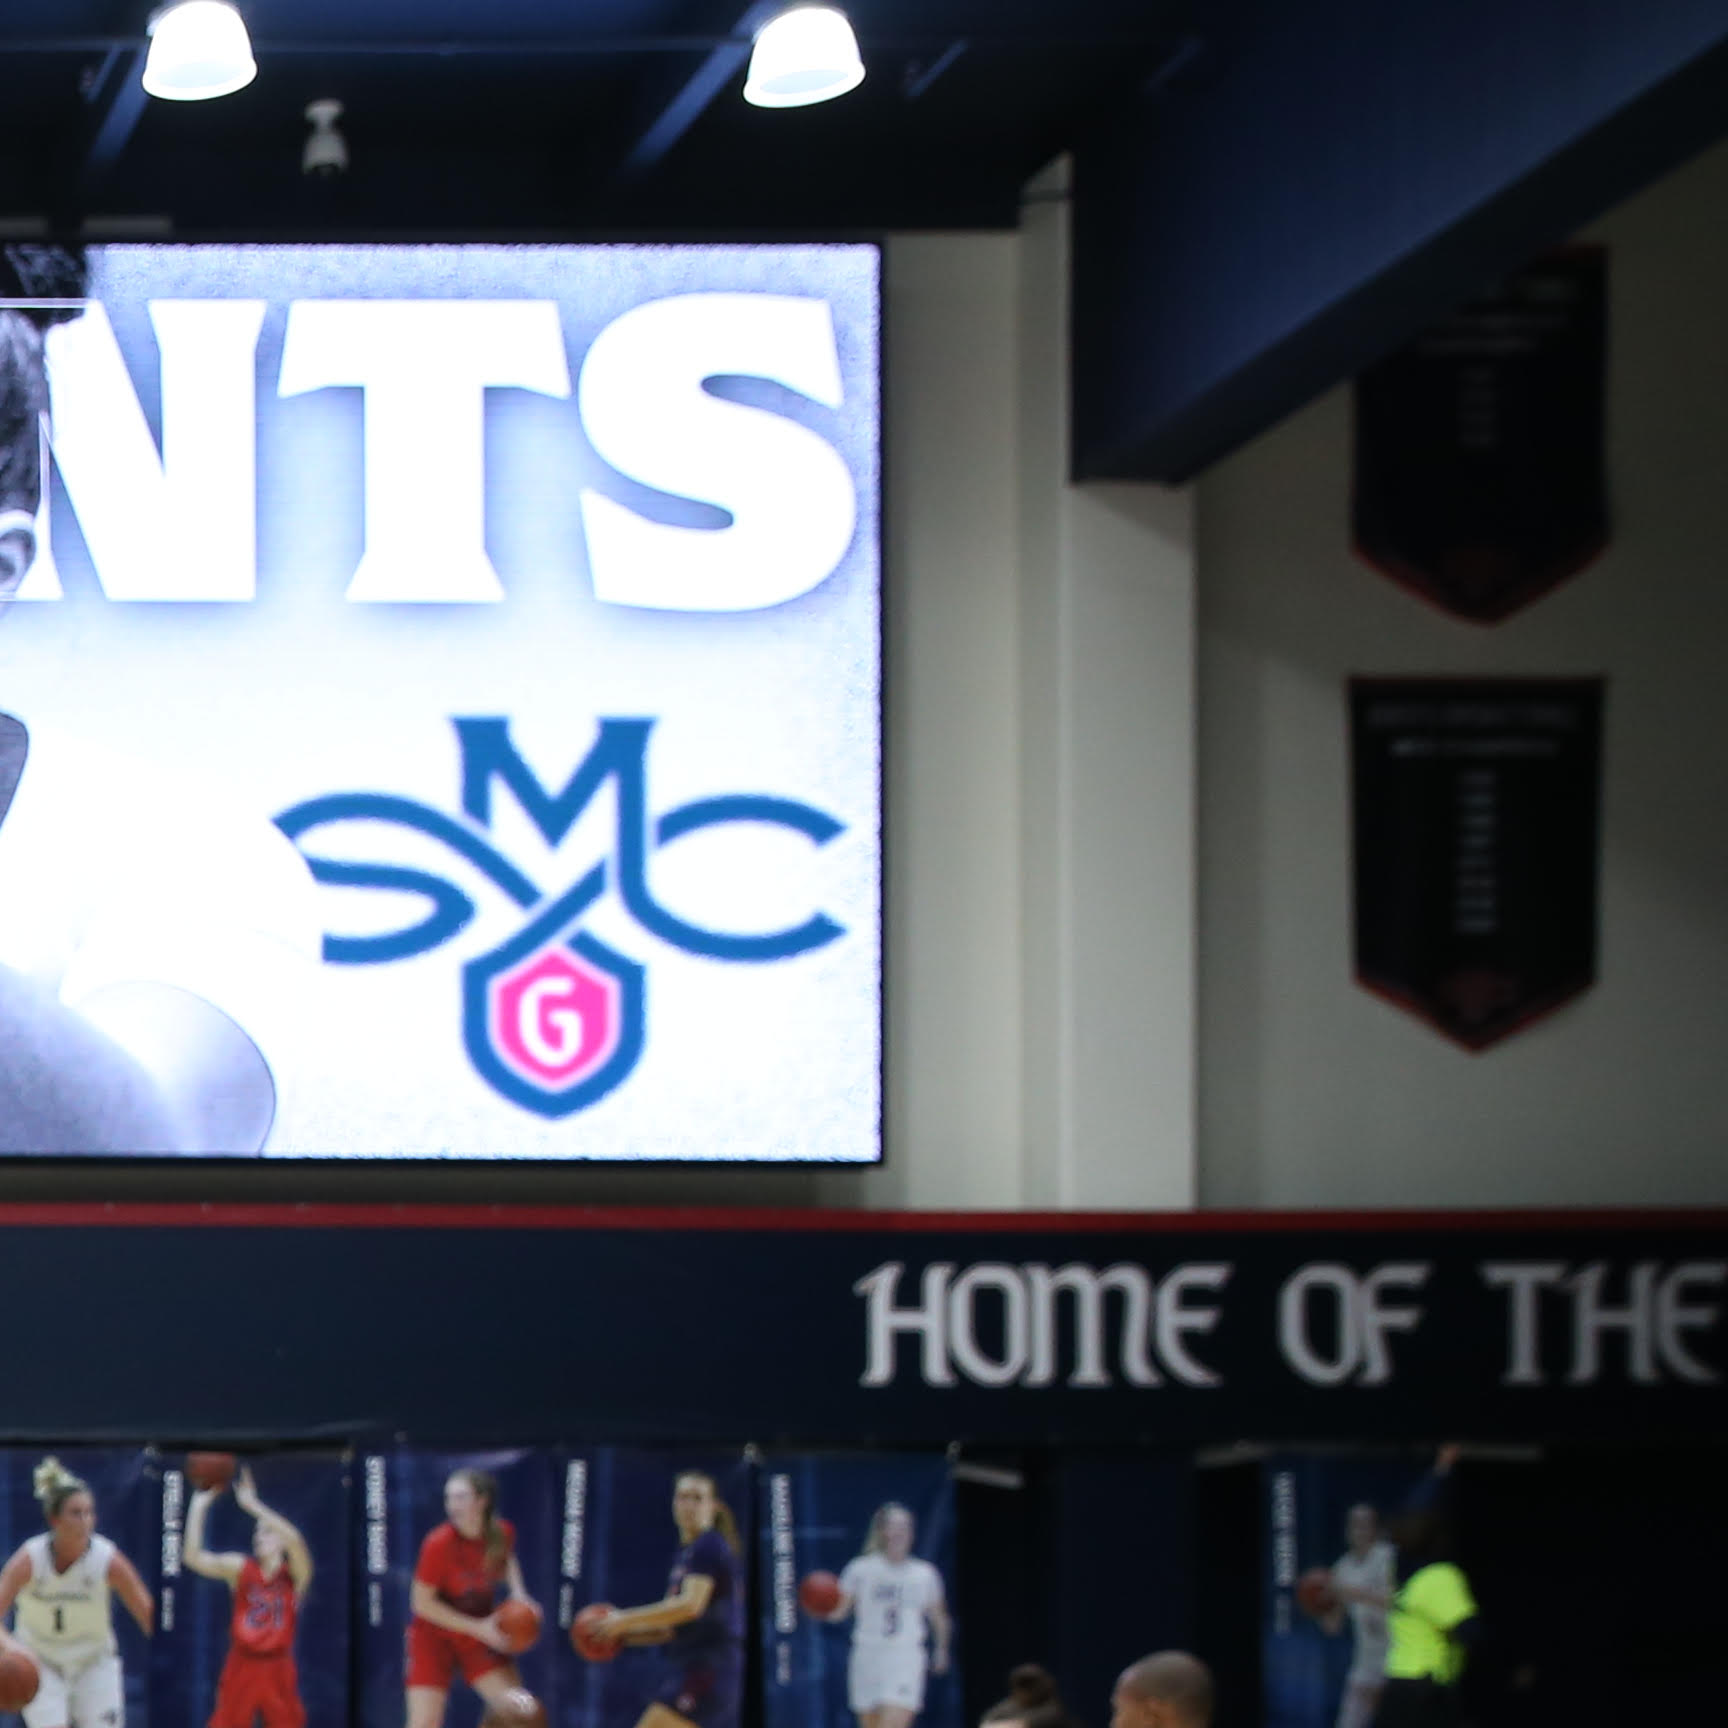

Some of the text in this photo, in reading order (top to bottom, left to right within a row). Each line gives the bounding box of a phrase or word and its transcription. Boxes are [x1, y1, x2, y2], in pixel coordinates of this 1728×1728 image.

[853, 1260, 1728, 1388] HOME OF THE
